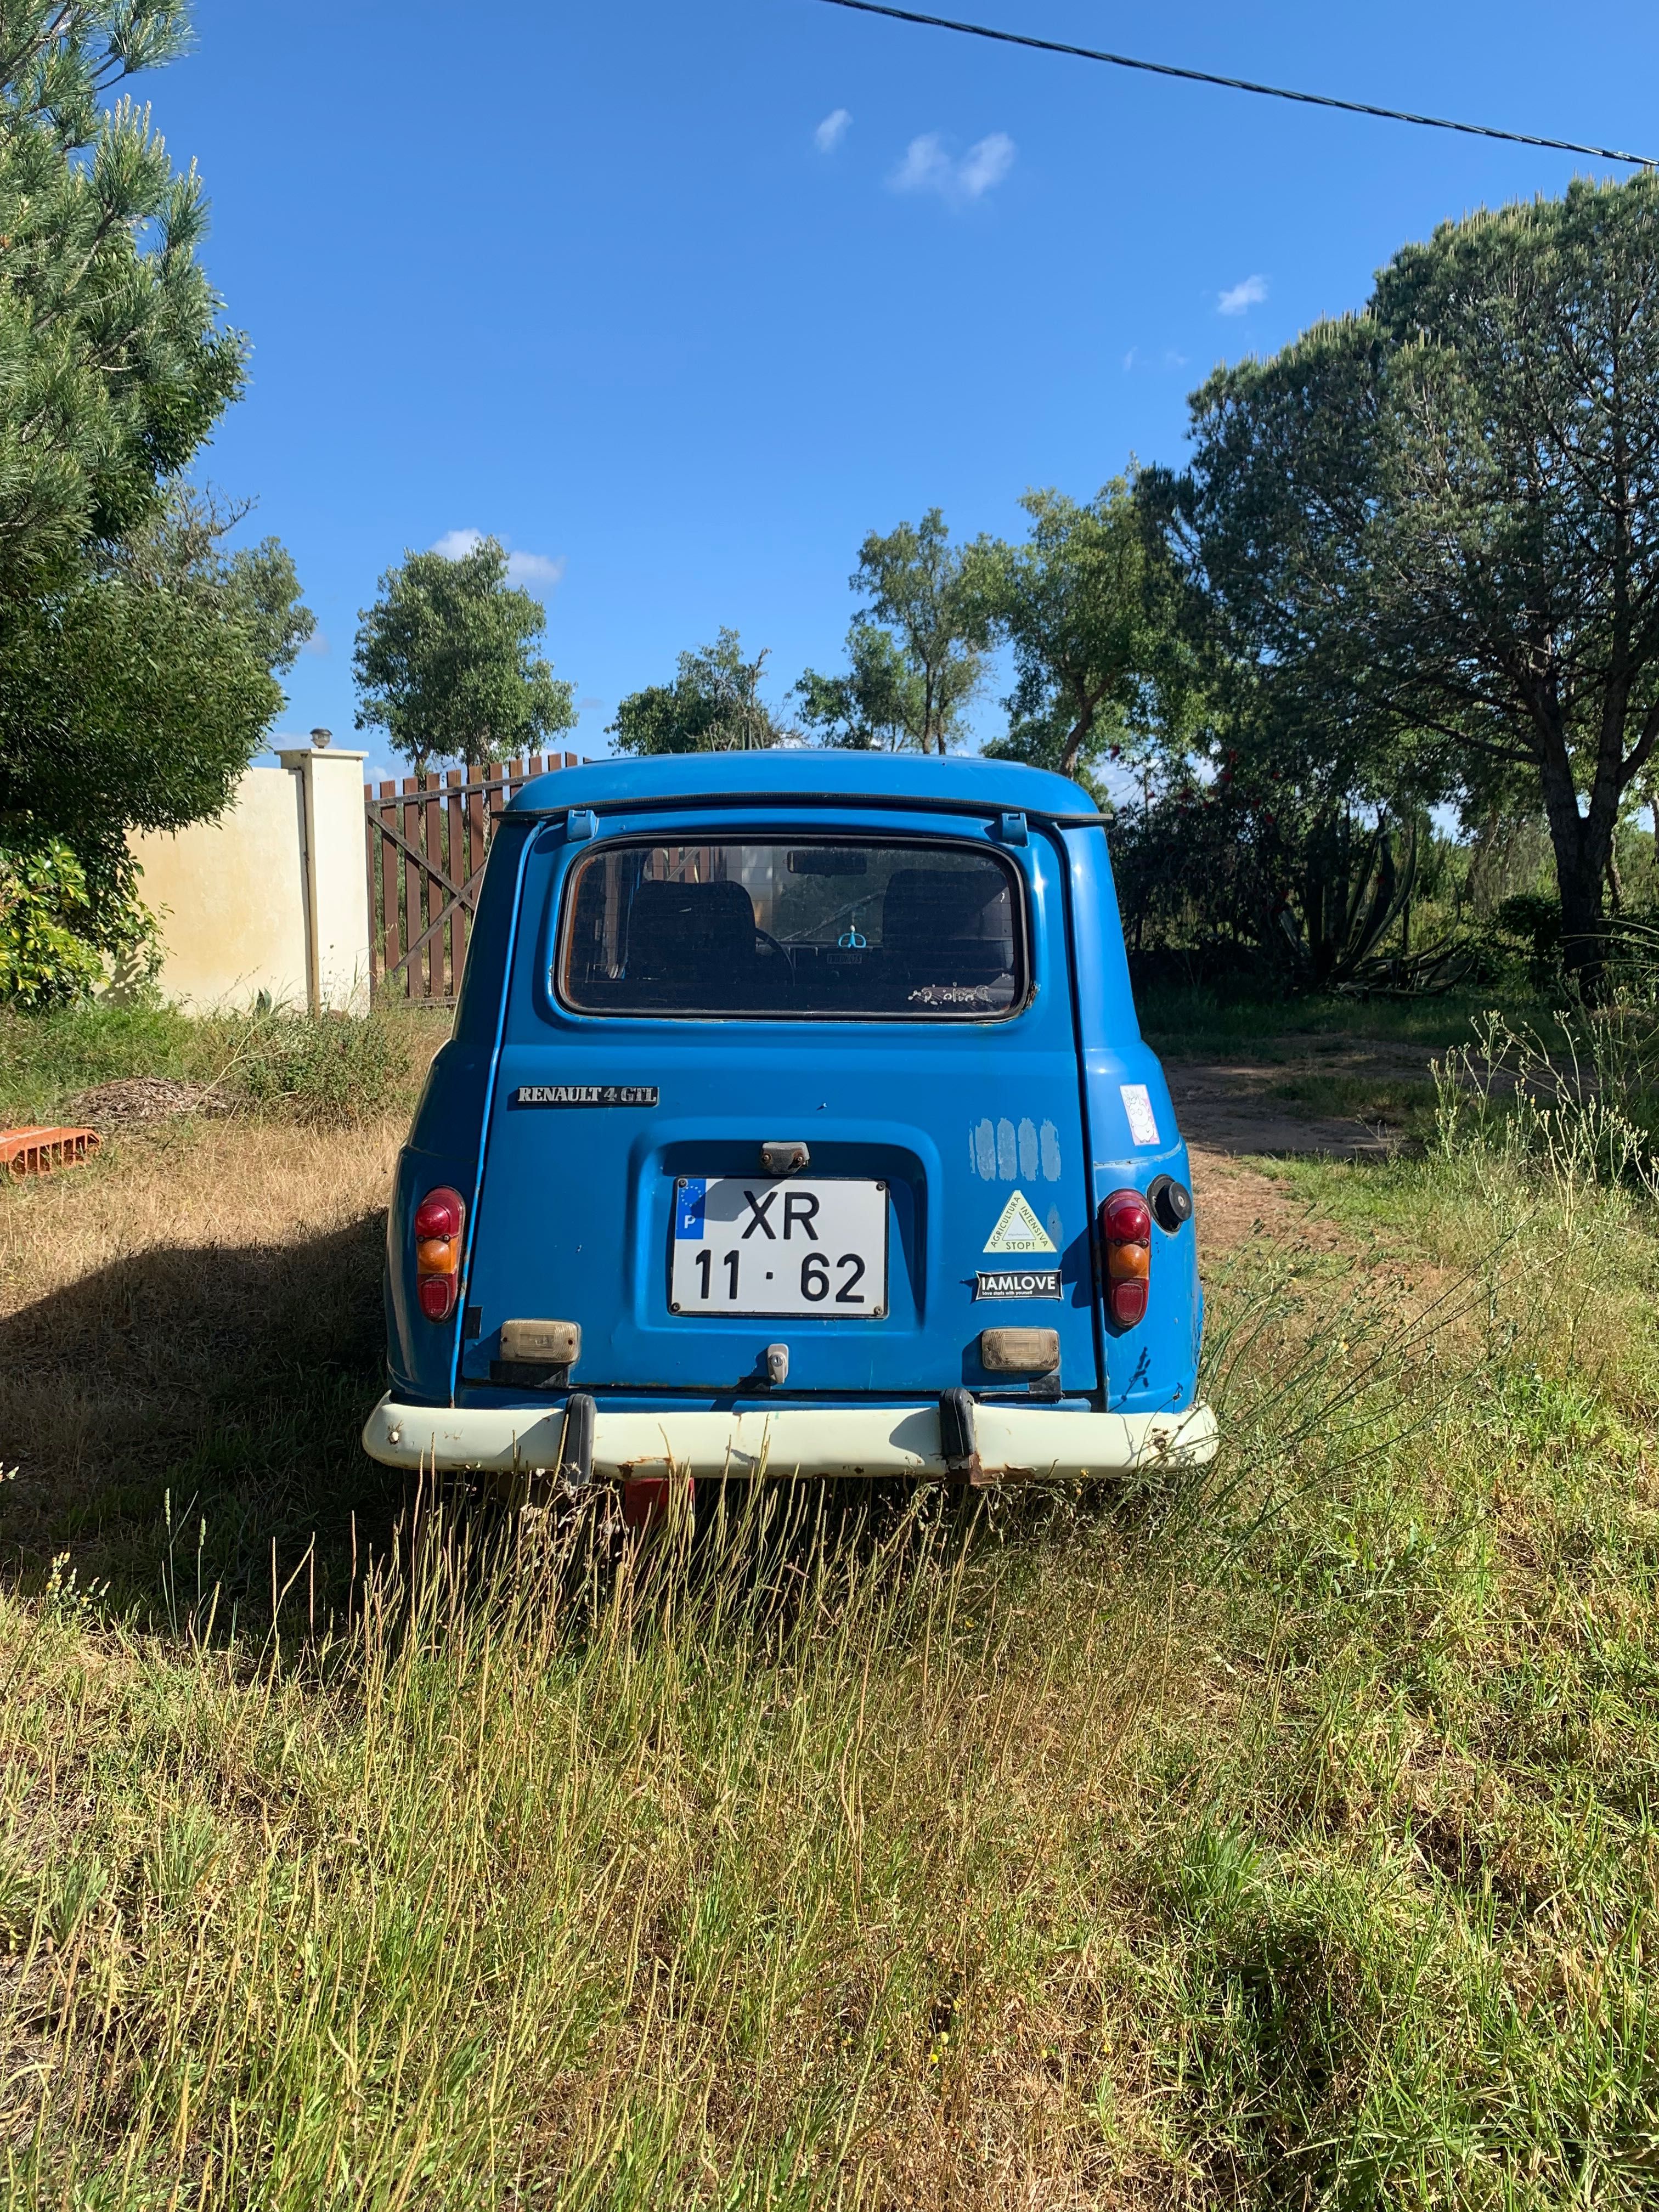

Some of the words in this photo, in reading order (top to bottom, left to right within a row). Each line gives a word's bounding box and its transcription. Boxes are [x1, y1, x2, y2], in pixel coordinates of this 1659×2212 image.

[517, 1087, 602, 1102] RENAULT
[603, 1087, 618, 1102] 4
[620, 1087, 657, 1102] GTL
[684, 1215, 696, 1229] P
[741, 1190, 820, 1240] XR
[991, 1197, 1021, 1248] AGRICULTURA
[1020, 1205, 1049, 1247] INTENSIVA
[1006, 1242, 1035, 1250] STOP!
[695, 1249, 740, 1300] 11
[800, 1252, 866, 1303] 62
[981, 1276, 1056, 1290] IAMLOVE
